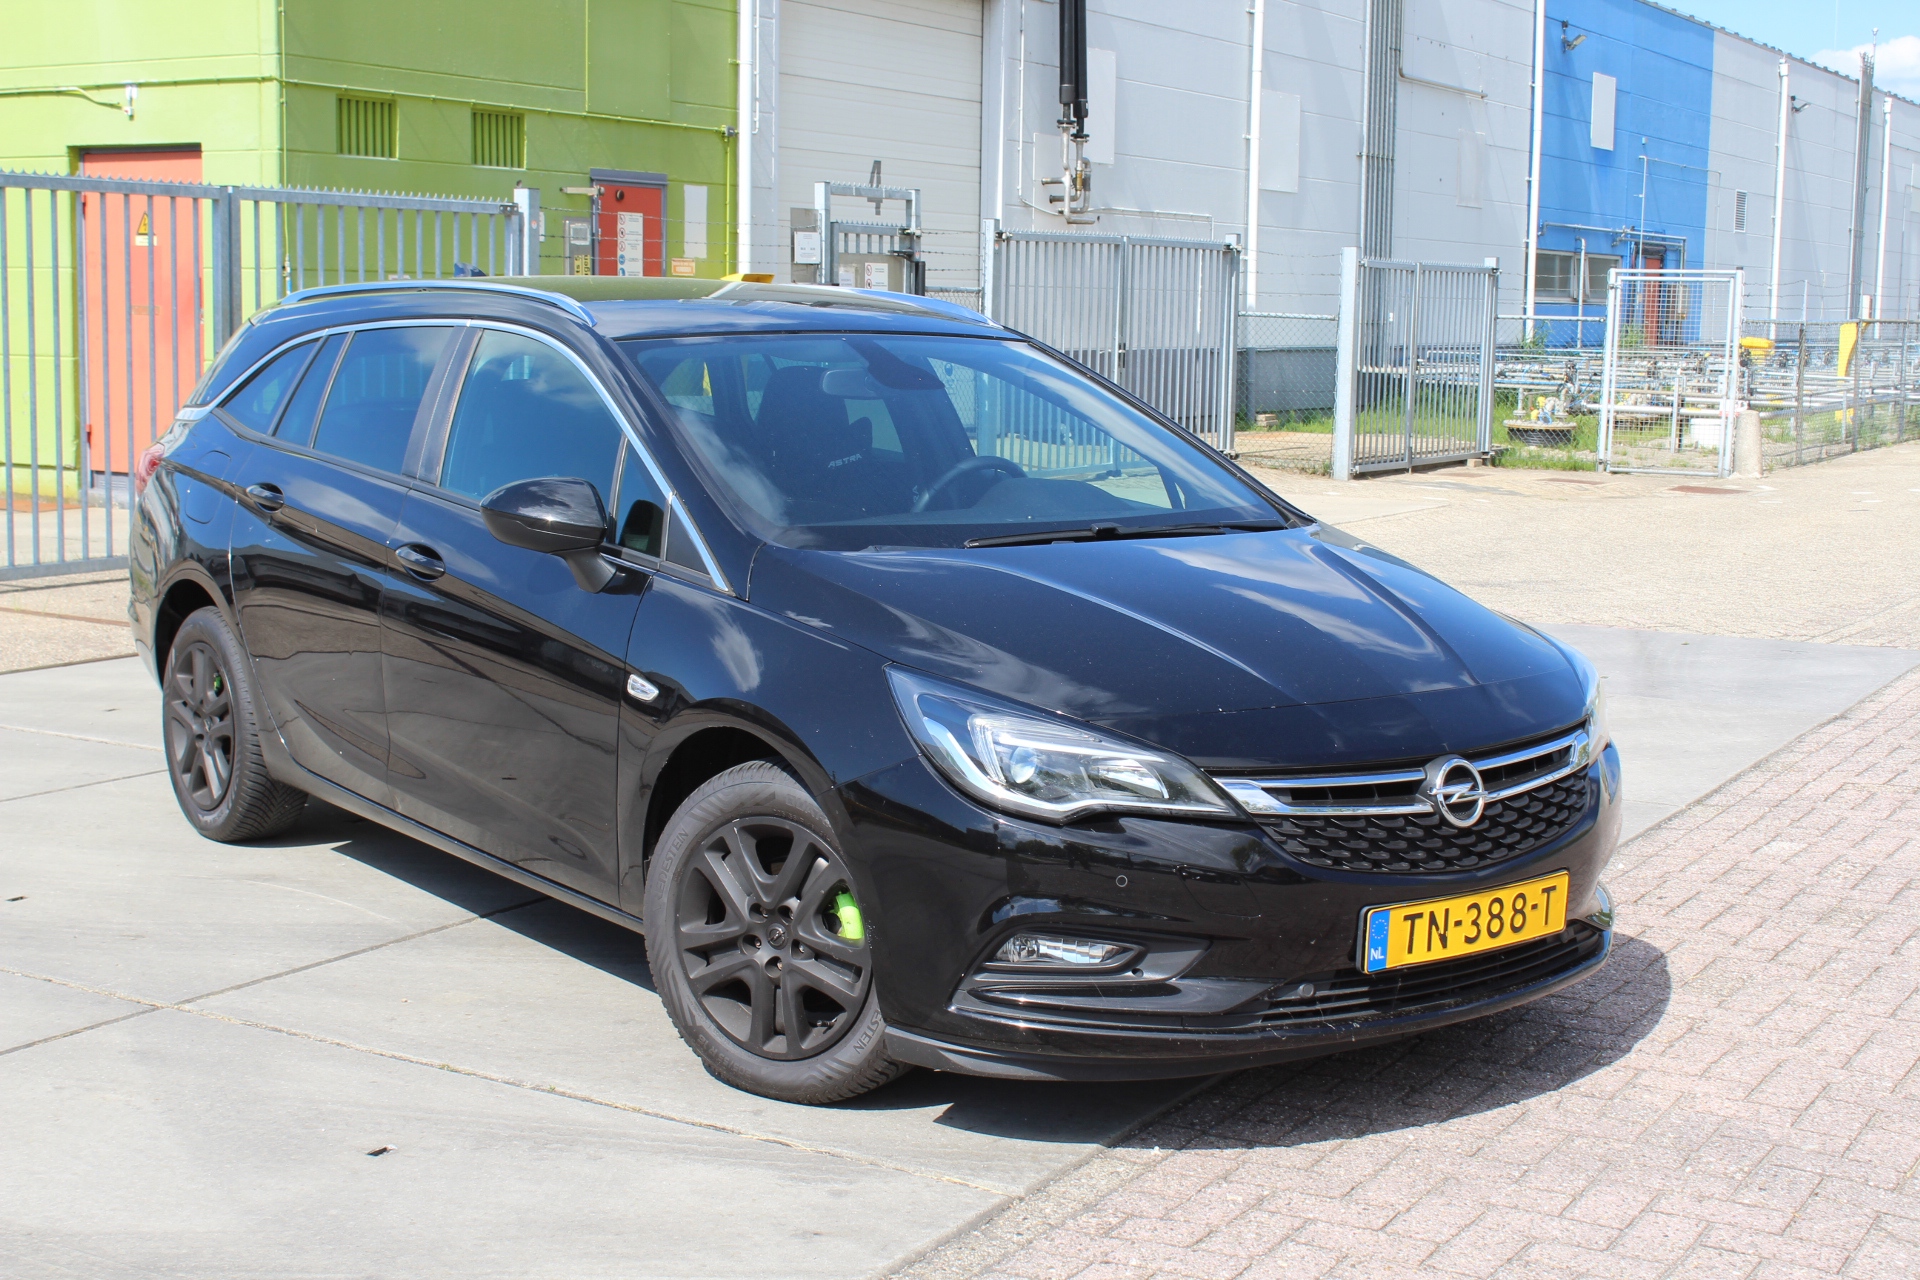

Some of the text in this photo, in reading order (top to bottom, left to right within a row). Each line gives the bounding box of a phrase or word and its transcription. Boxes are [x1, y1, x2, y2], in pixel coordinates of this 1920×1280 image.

[866, 160, 883, 216] 4
[828, 453, 862, 467] ASTRA
[1403, 885, 1557, 954] TN-388-T
[1370, 948, 1384, 960] NL
[853, 1009, 882, 1054] ESTEIN
